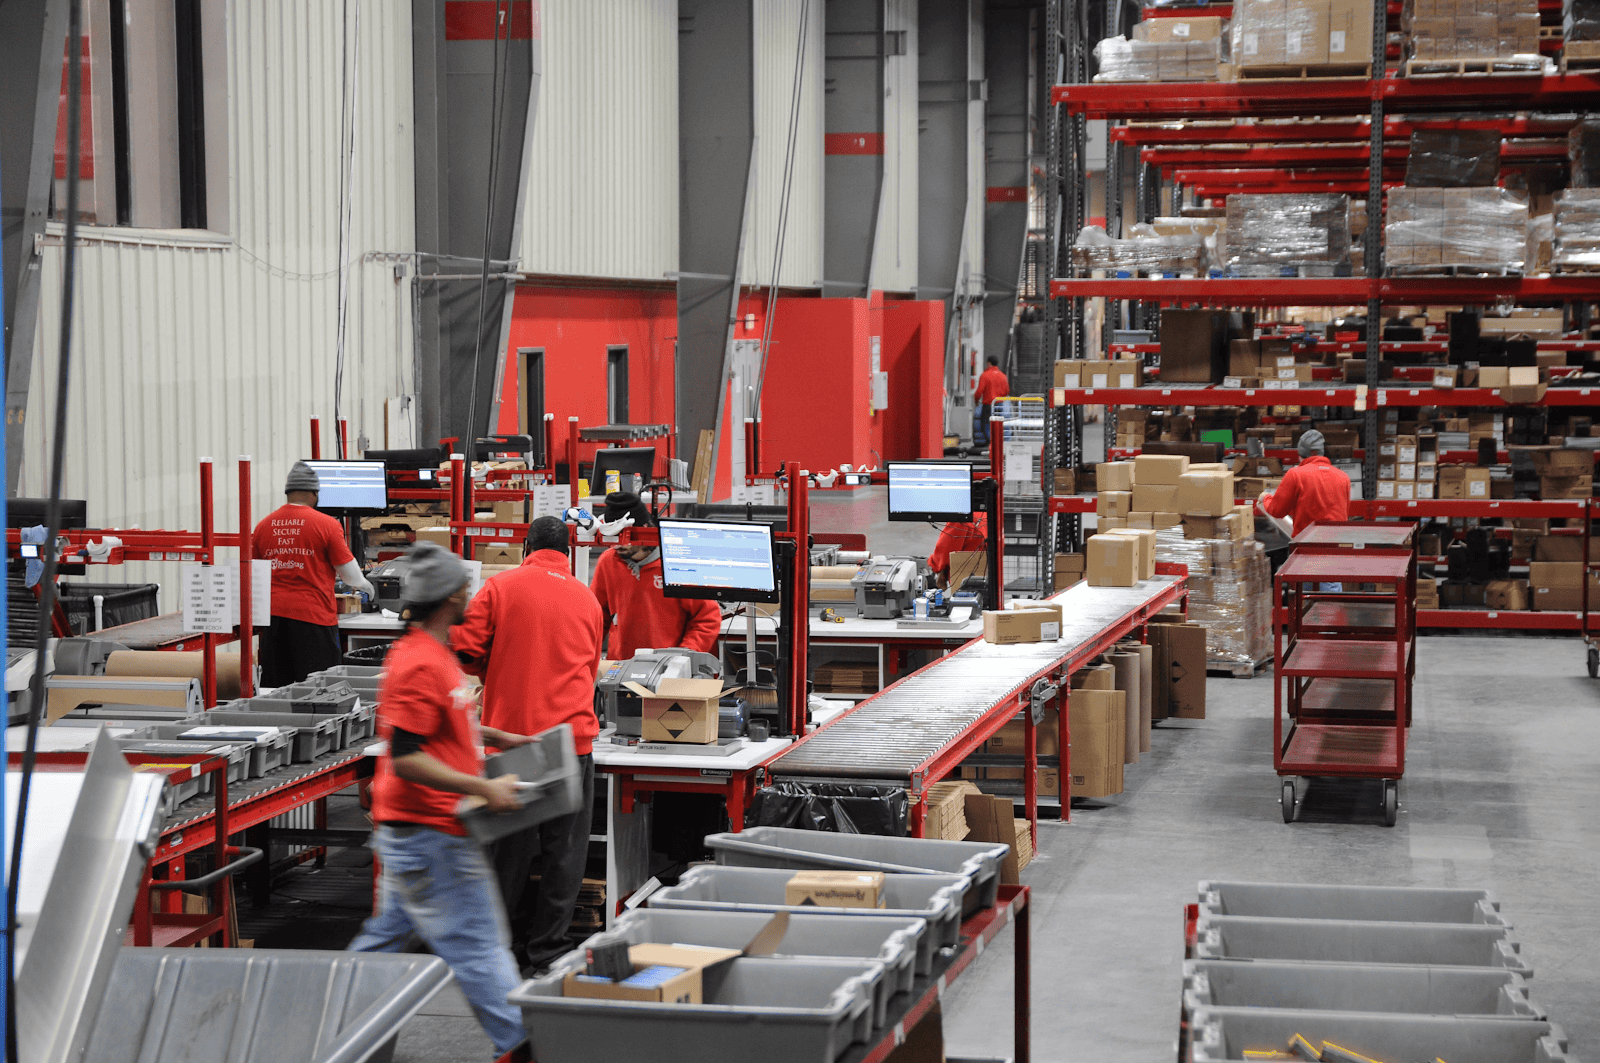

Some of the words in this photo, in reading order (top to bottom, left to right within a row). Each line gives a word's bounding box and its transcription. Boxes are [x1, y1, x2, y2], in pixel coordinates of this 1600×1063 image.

[499, 11, 506, 25] 7
[271, 519, 305, 527] RELIABLE
[273, 528, 301, 536] SECURE
[278, 538, 295, 546] FAST
